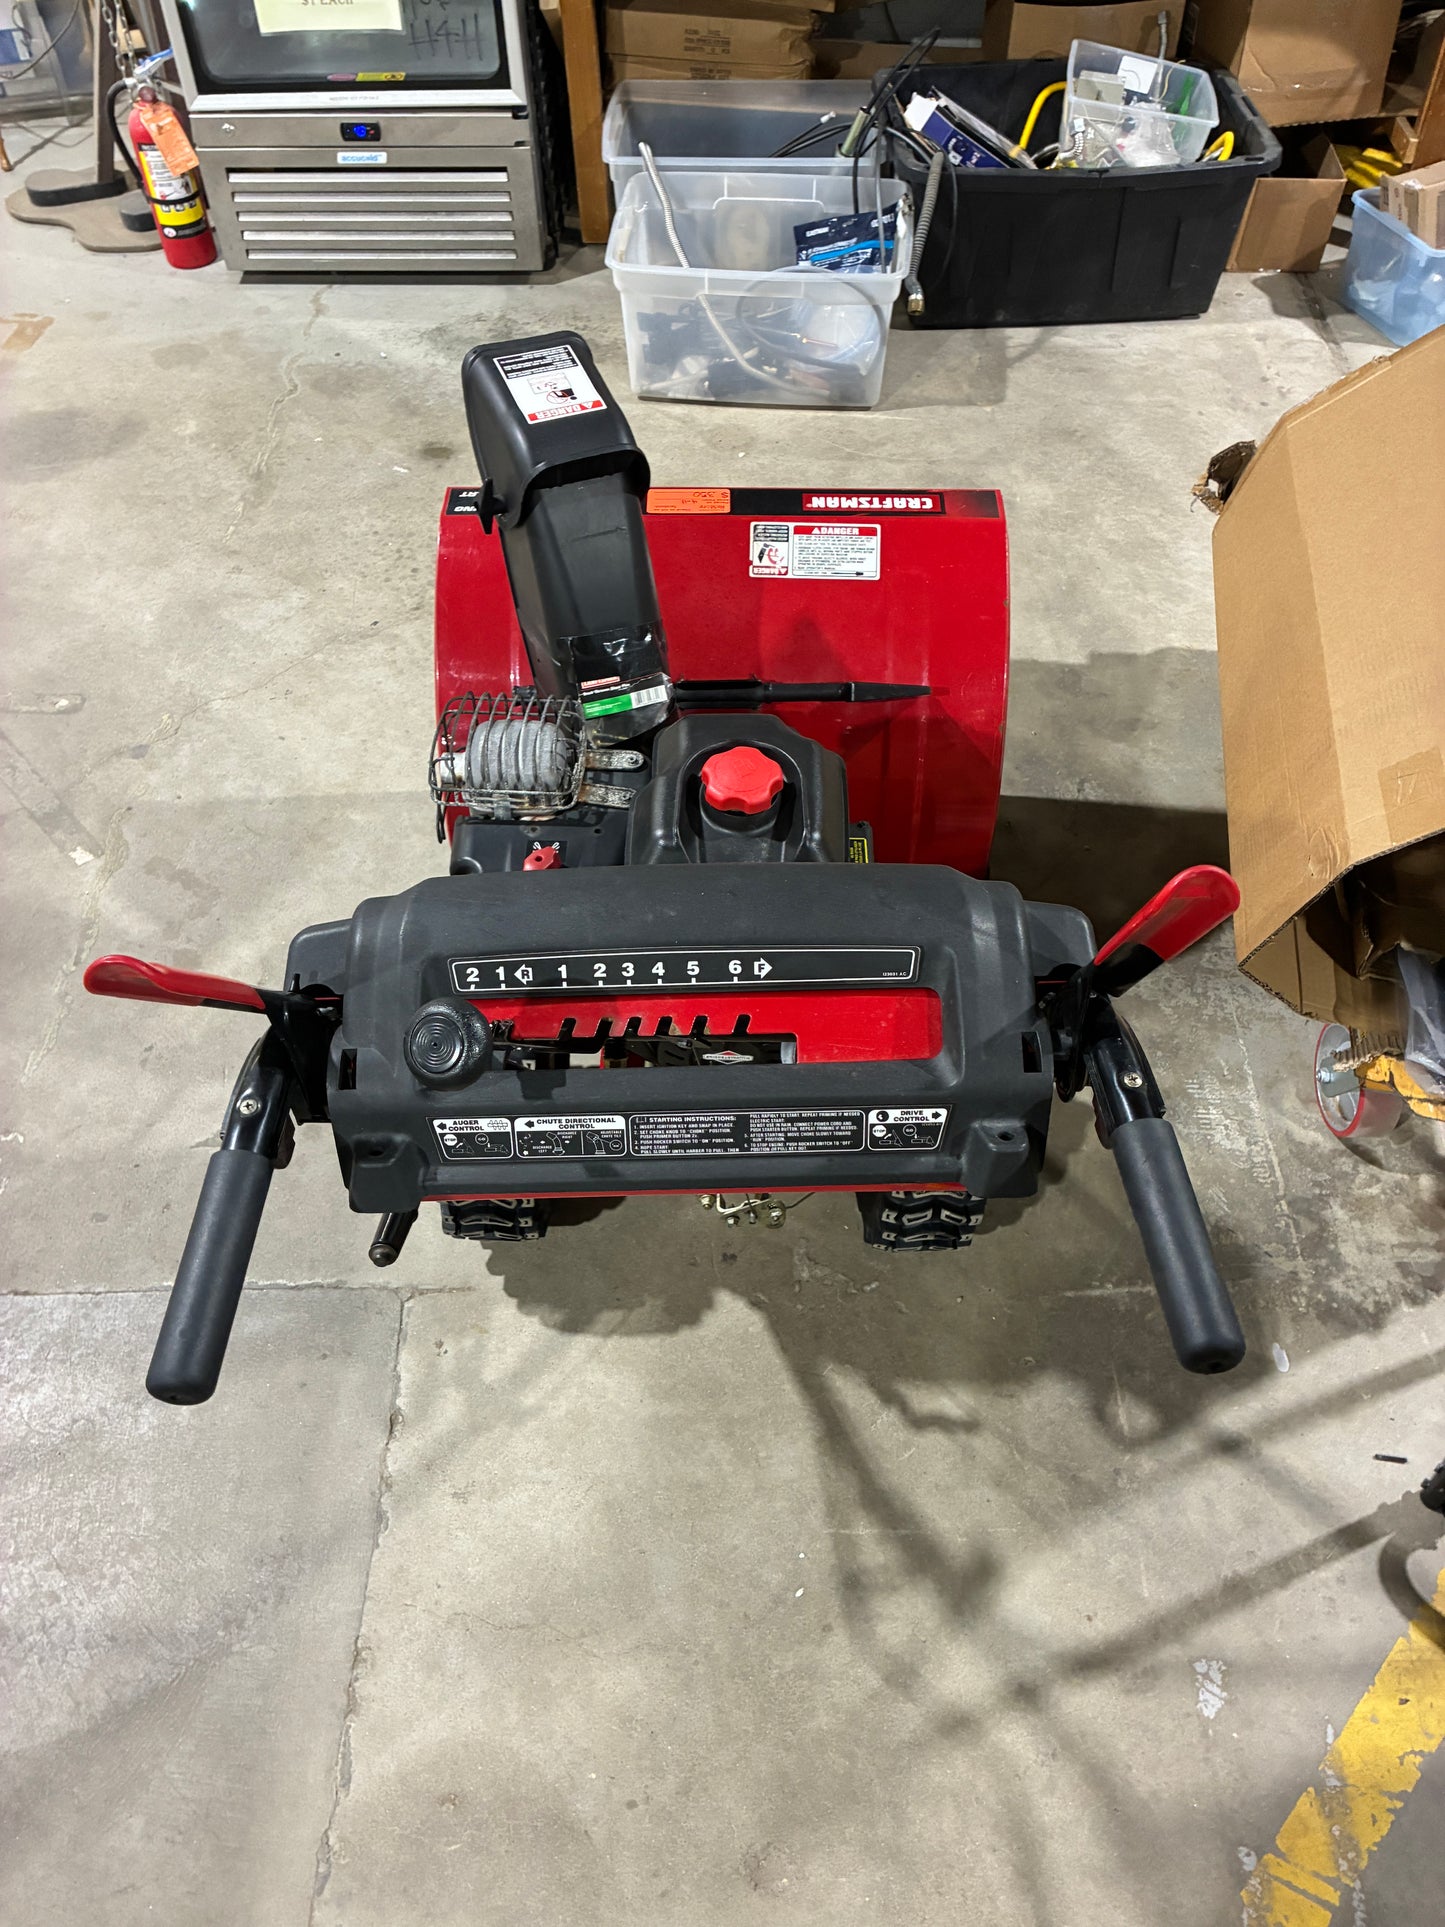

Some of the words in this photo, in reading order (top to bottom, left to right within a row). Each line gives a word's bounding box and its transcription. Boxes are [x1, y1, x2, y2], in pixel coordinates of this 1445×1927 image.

[535, 403, 581, 420] DANGER
[811, 496, 933, 510] CRAFTSMAN
[820, 527, 860, 535] DANGER
[466, 968, 480, 982] 2
[496, 966, 505, 980] 1
[521, 970, 530, 979] R
[558, 965, 567, 978] 1
[593, 963, 607, 977] 2
[621, 962, 635, 976] 3
[652, 962, 665, 976] 4
[686, 961, 700, 975] 5
[728, 960, 742, 974] 6
[758, 964, 765, 973] F
